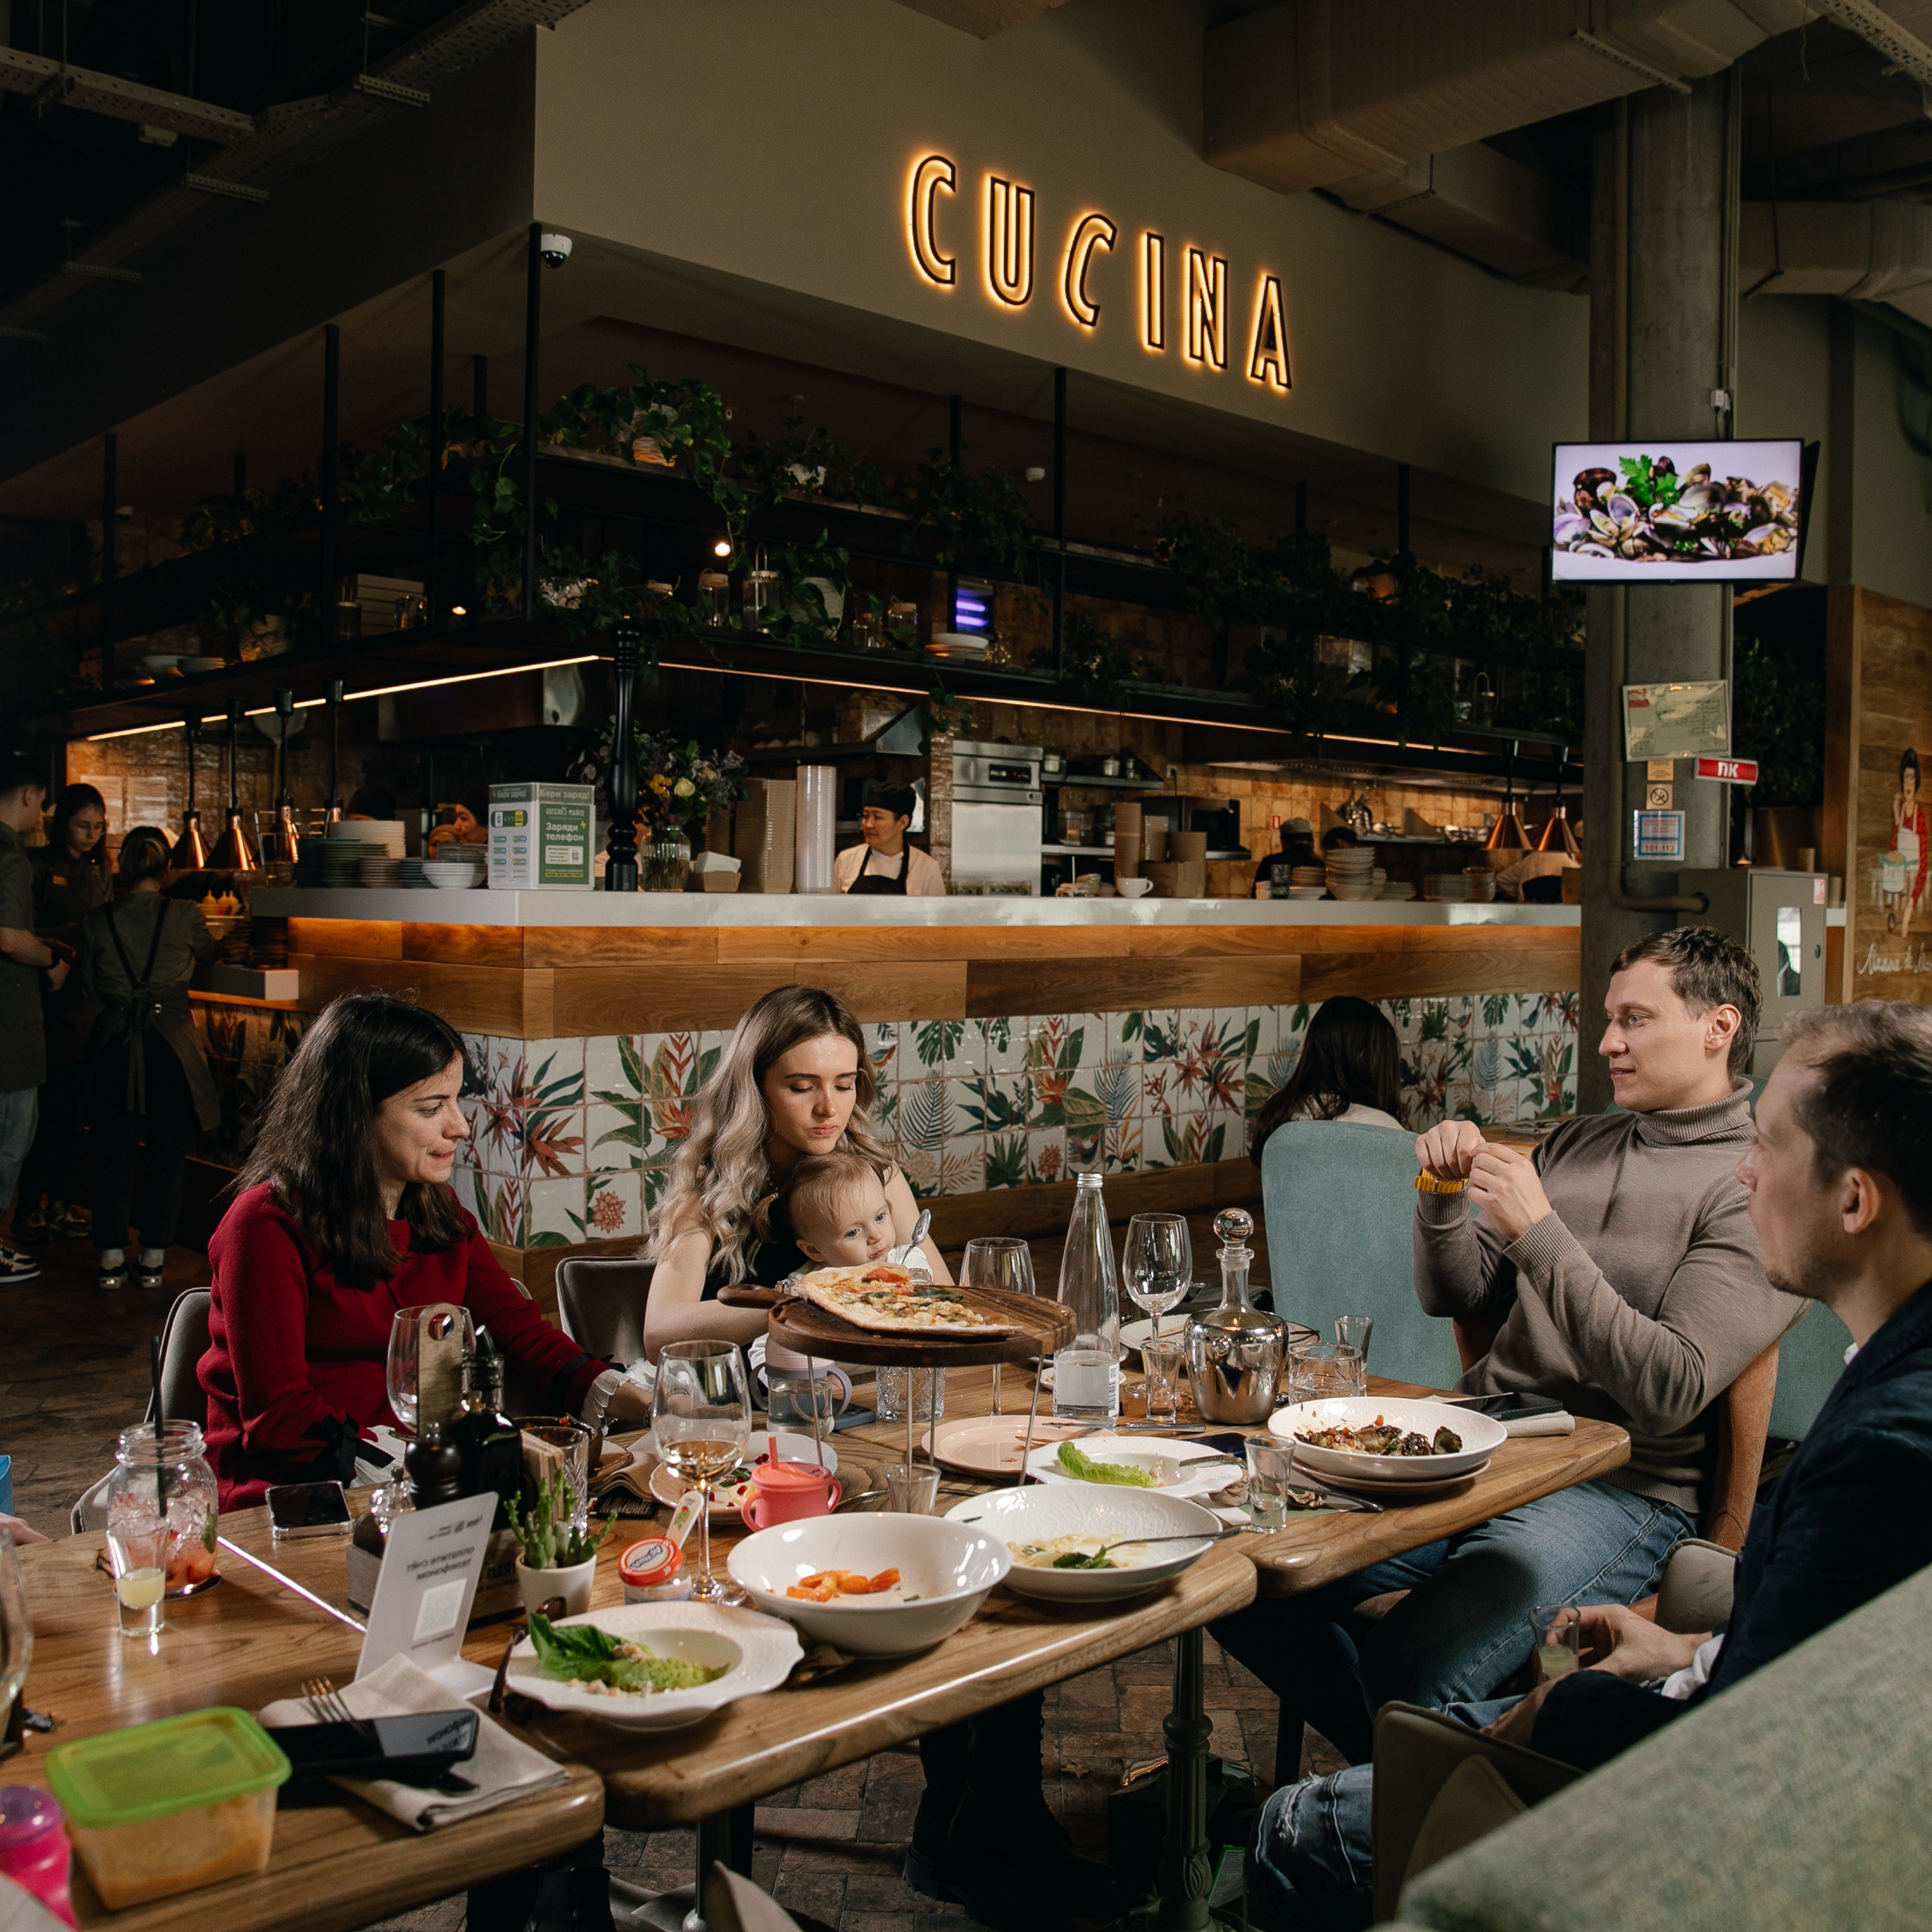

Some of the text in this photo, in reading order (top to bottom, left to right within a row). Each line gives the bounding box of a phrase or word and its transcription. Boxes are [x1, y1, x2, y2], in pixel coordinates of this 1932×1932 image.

[908, 154, 1292, 390] CUCINA
[1717, 761, 1740, 778] ПК
[540, 789, 589, 800] Бери заряд!
[546, 822, 579, 832] Заряди
[546, 833, 585, 843] телефон
